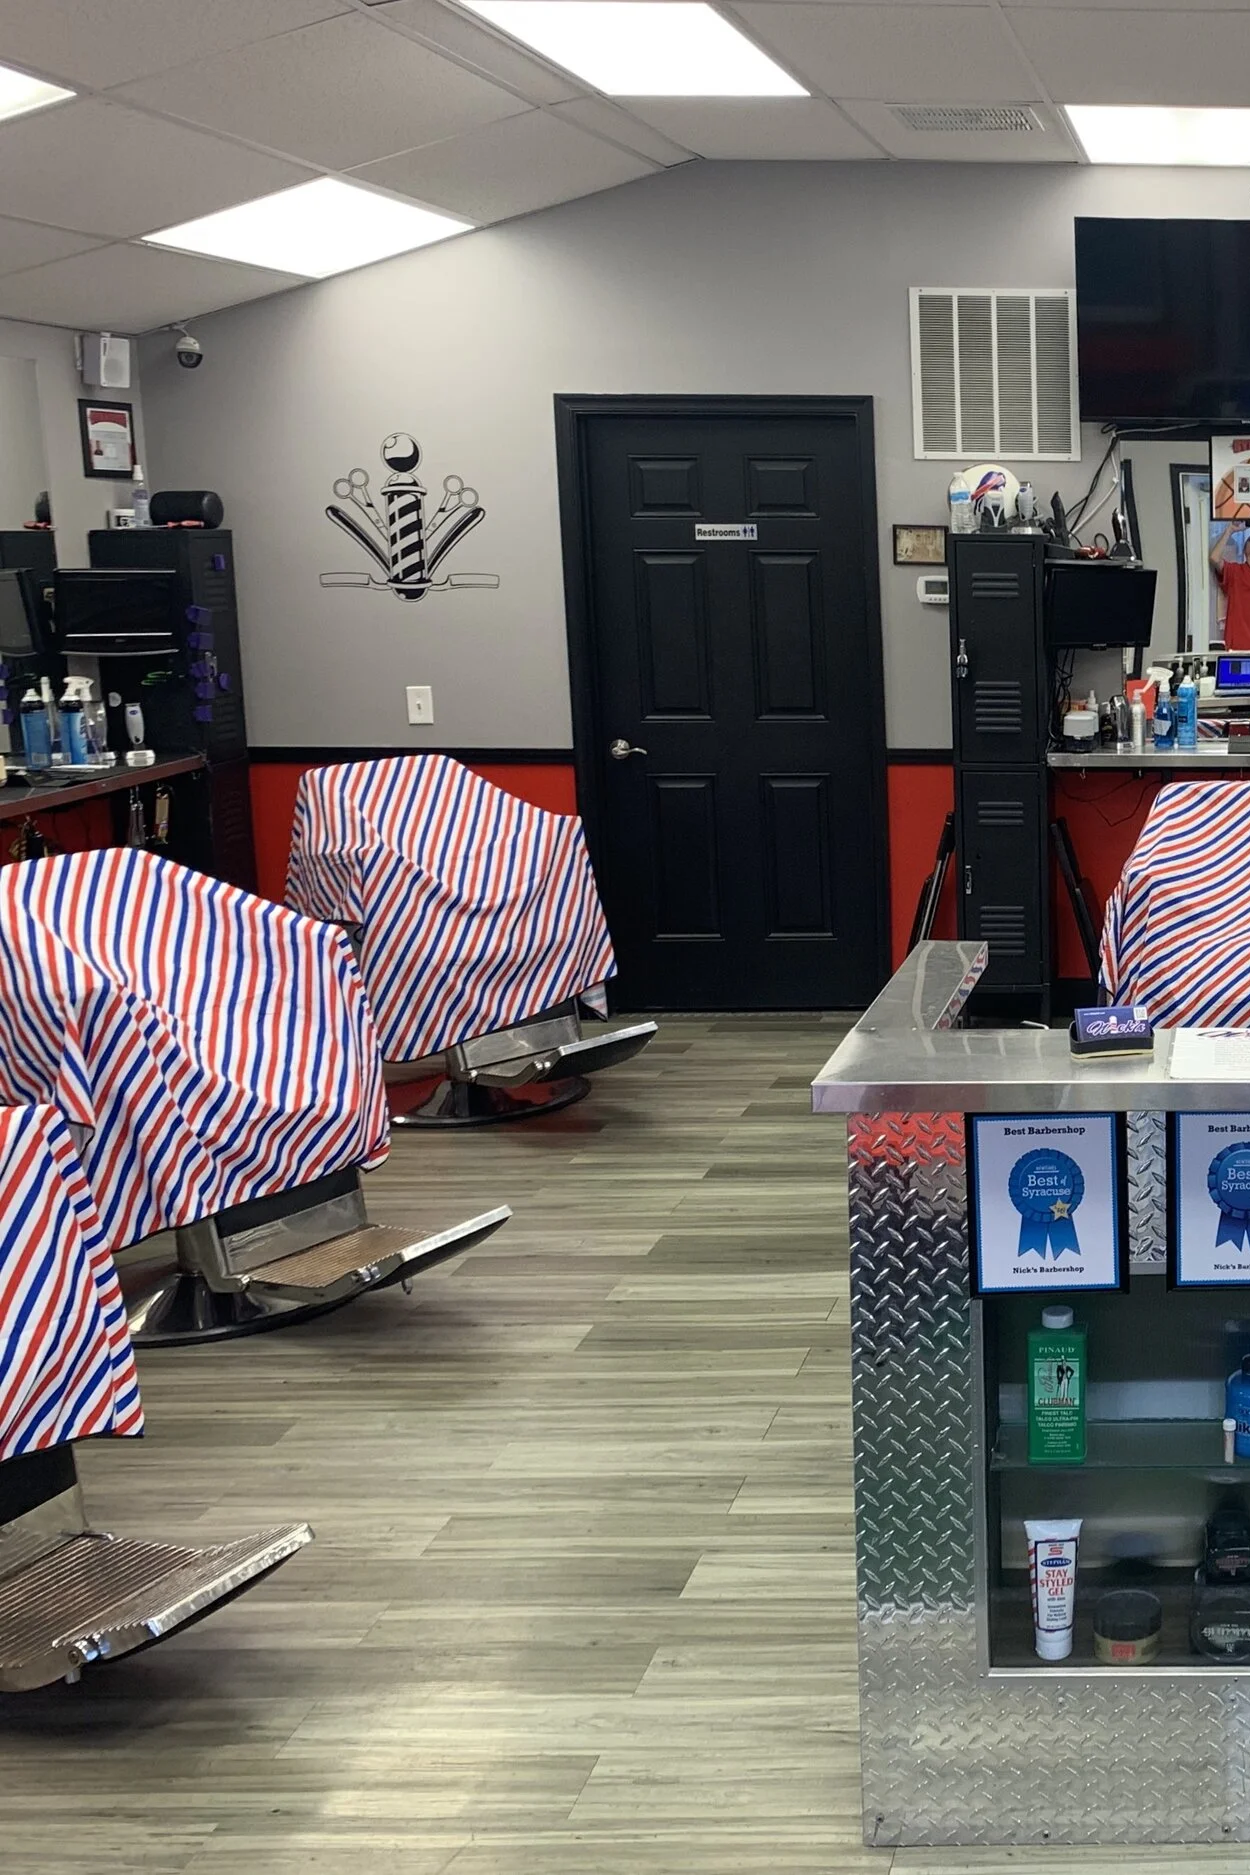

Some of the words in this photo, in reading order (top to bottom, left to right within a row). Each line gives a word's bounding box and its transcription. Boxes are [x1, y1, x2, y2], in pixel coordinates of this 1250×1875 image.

[697, 528, 741, 537] Restrooms
[1004, 1127, 1026, 1136] Best
[1028, 1126, 1086, 1136] Barbershop
[1208, 1125, 1229, 1133] Best
[1028, 1174, 1058, 1186] Best
[1060, 1175, 1068, 1187] of
[1022, 1187, 1072, 1199] Syracuse
[1012, 1266, 1038, 1274] Nick's
[1039, 1266, 1085, 1275] Barbershop
[1038, 1397, 1076, 1406] CLUBMAN
[1045, 1569, 1067, 1578] STAY
[1040, 1577, 1073, 1587] STYLED
[1048, 1587, 1065, 1596] GEL
